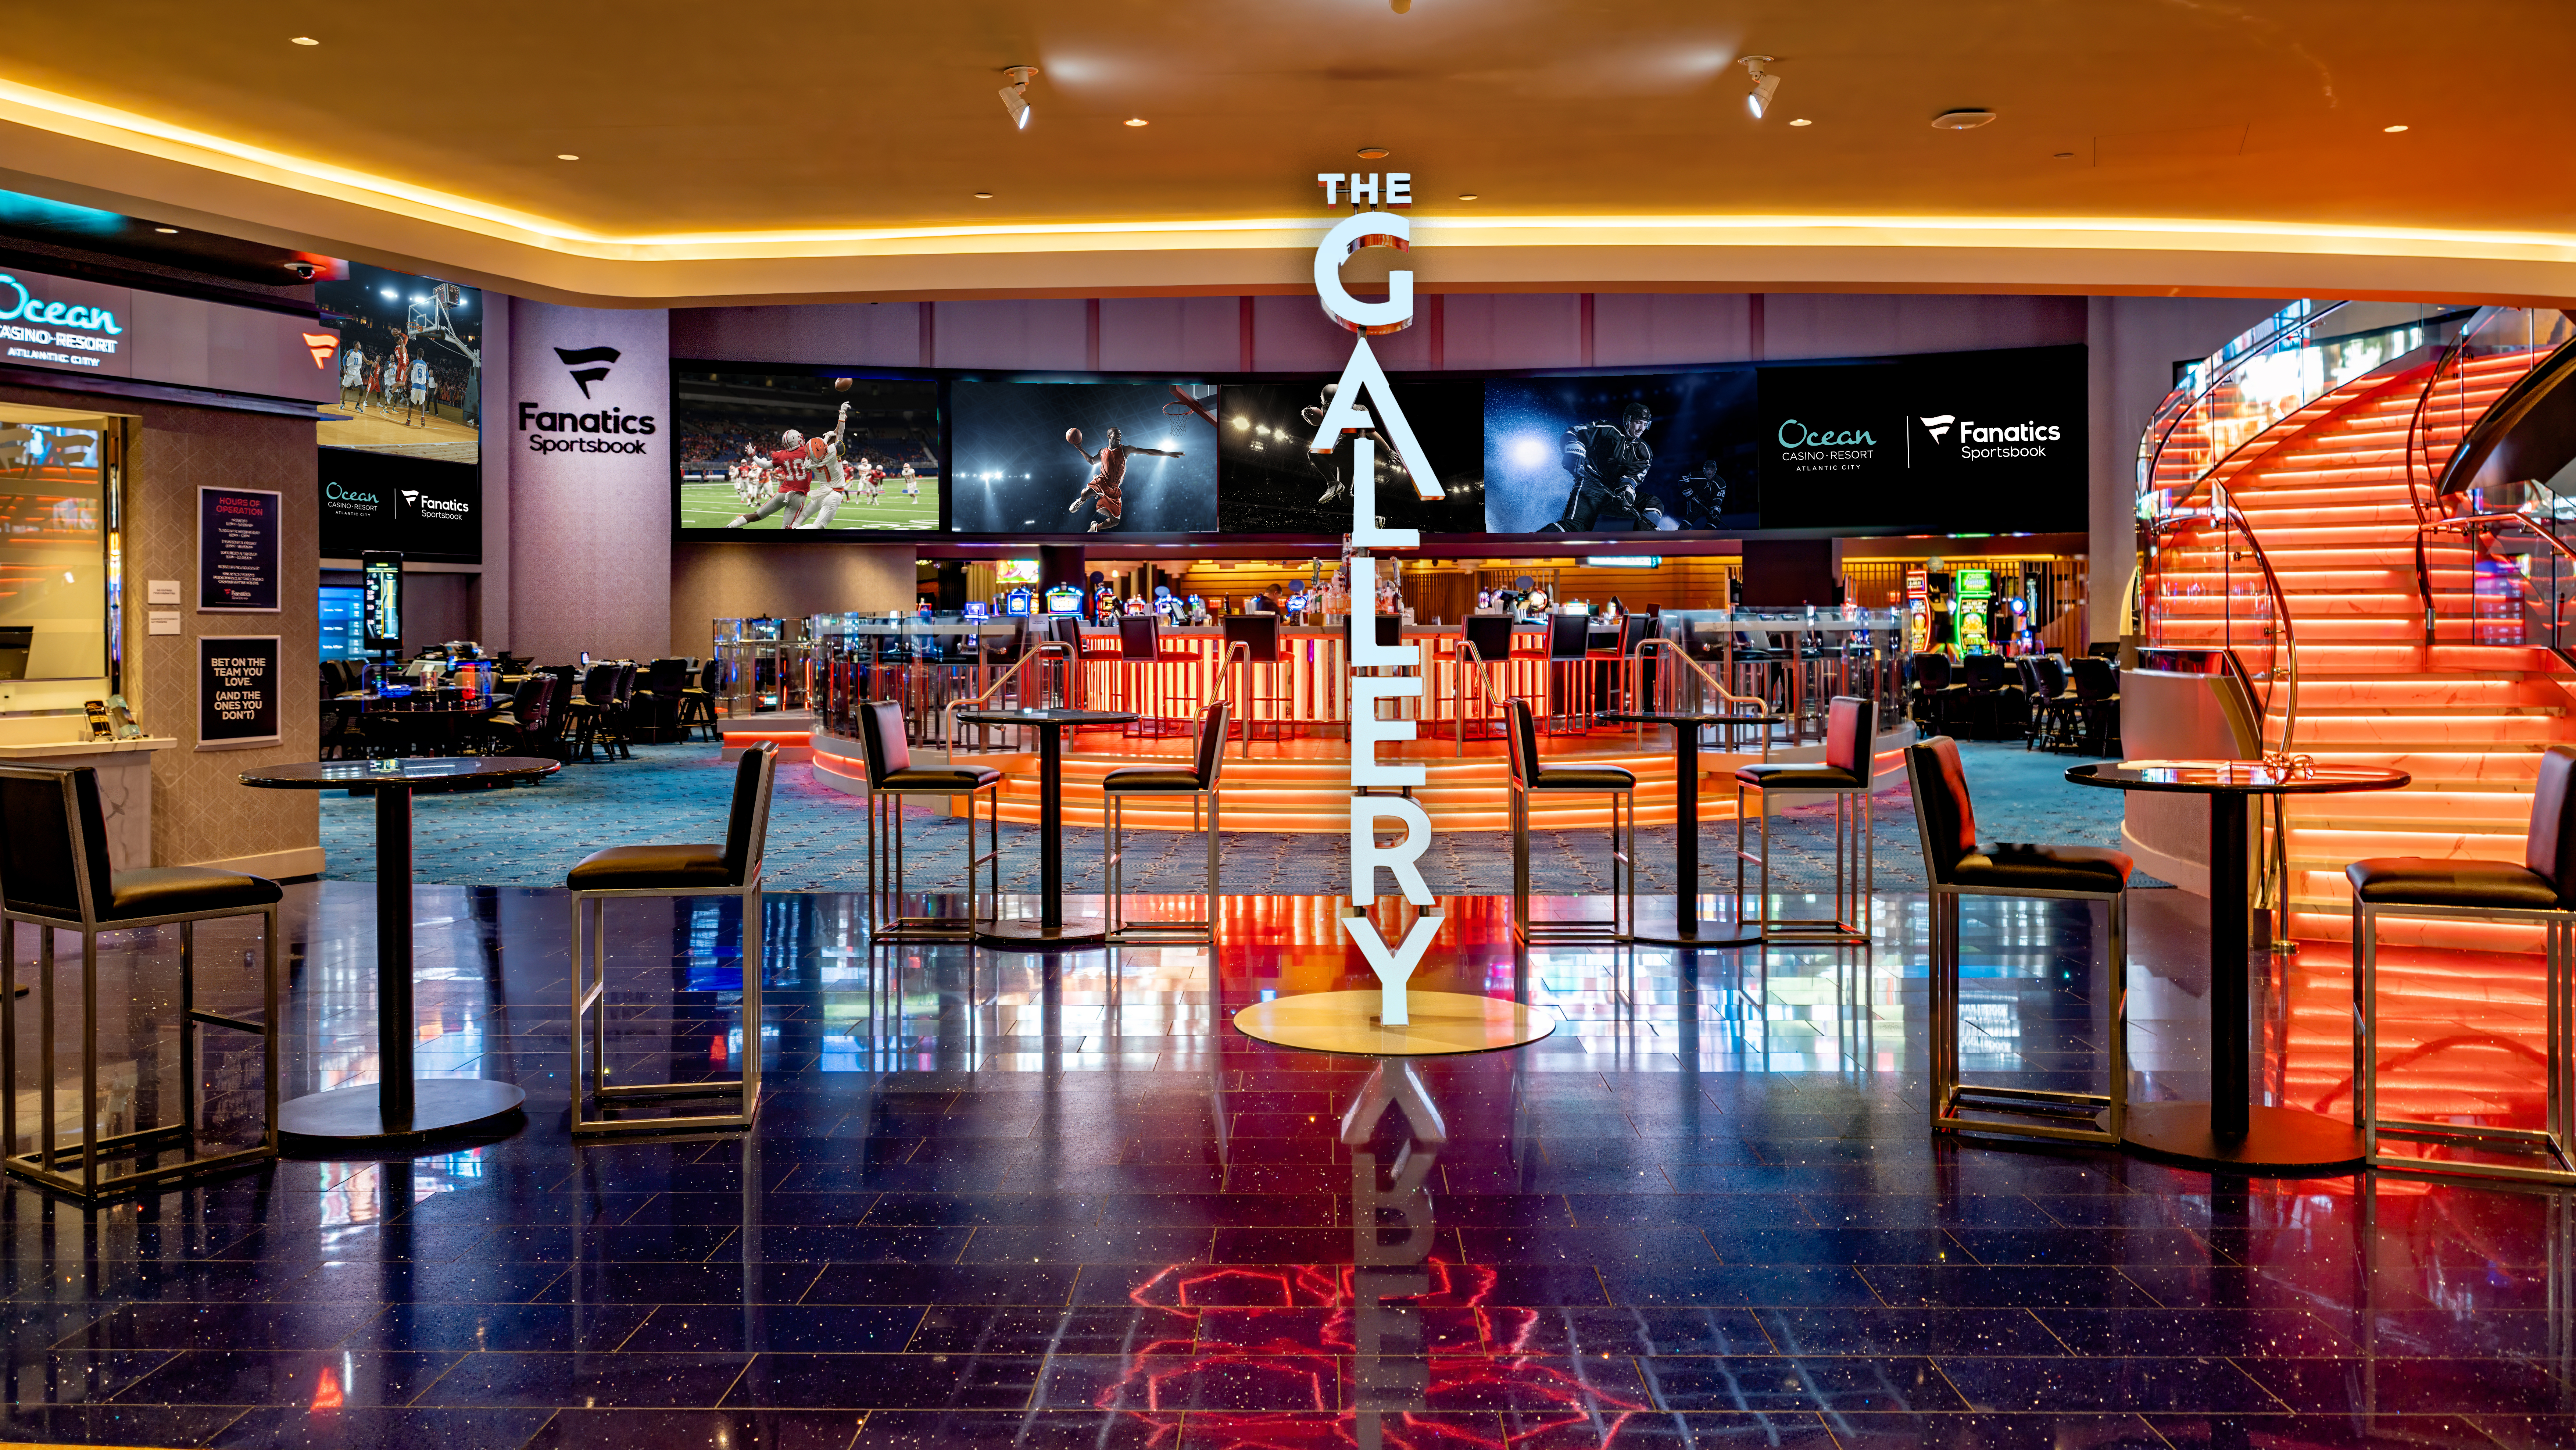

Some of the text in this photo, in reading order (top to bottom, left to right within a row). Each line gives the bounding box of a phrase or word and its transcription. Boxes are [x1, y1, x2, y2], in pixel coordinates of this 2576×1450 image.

[1318, 173, 1412, 204] THE
[0, 273, 123, 335] Ocean
[7, 347, 100, 367] ATLANTIC CITY
[354, 357, 358, 365] 11
[418, 368, 422, 378] 6
[519, 402, 655, 435] Fanatics
[1778, 419, 1877, 448] Ocean
[1961, 420, 2061, 443] Fanatics
[530, 434, 647, 455] Sportsbook
[1961, 446, 2046, 461] Sportsbook
[783, 458, 807, 481] 10
[816, 464, 831, 482] 7
[326, 482, 379, 503] Ocean
[219, 497, 248, 507] HOURS
[421, 495, 469, 512] Fanatics
[216, 505, 263, 516] OPERATION
[422, 510, 462, 520] Sportsbook
[1310, 211, 1446, 1026] GALLERY
[211, 658, 266, 667] BET ON THE
[214, 668, 263, 676] TEAM YOU
[225, 677, 253, 686] LOVE.
[216, 691, 261, 701] (AND THE
[214, 701, 262, 710] ONES YOU
[222, 710, 255, 720] DON'T)
